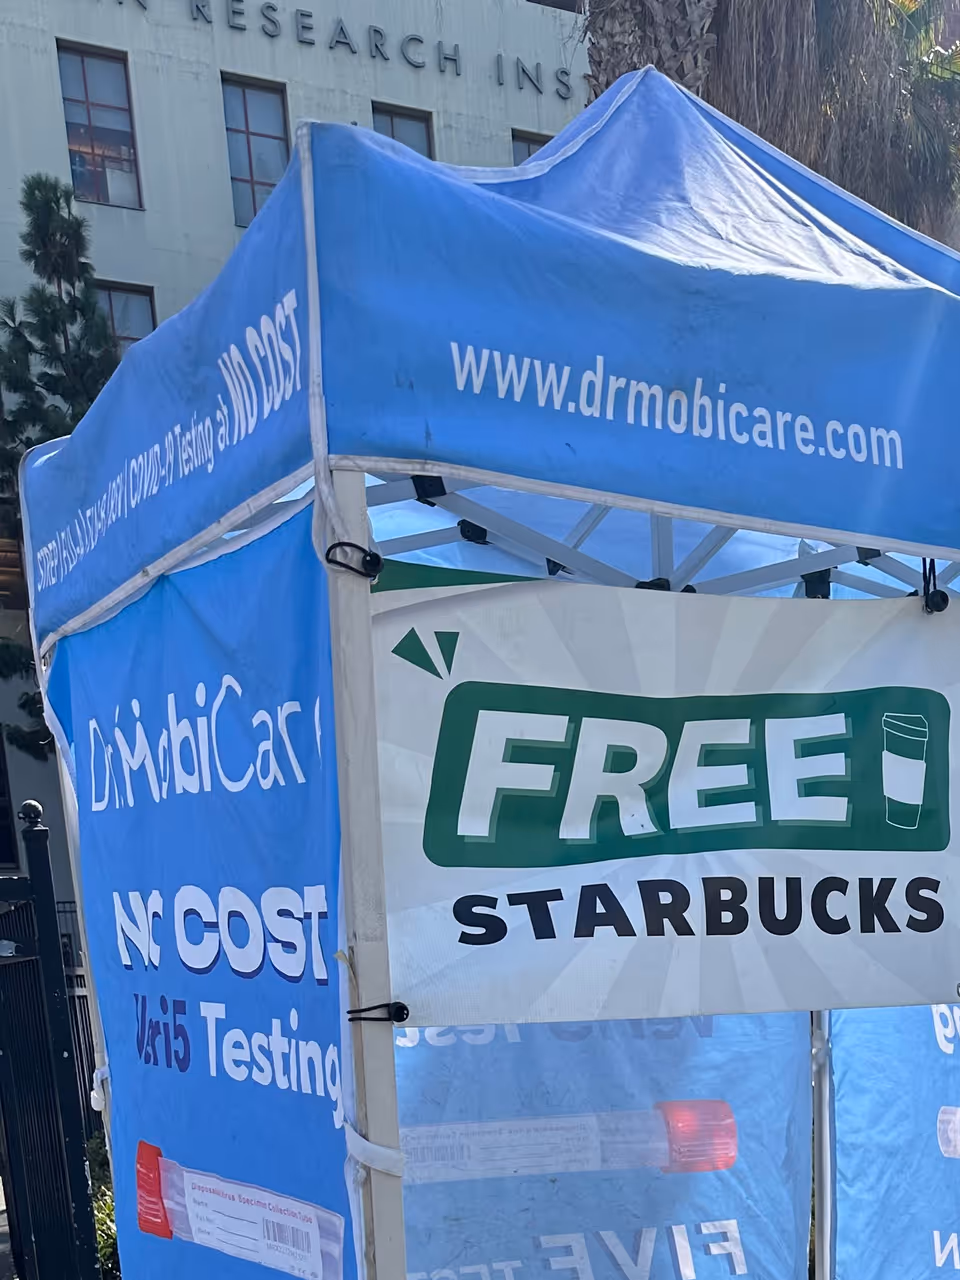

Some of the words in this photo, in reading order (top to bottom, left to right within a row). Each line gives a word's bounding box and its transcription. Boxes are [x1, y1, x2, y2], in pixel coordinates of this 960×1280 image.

[189, 0, 462, 77] RESEARCH
[217, 344, 258, 445] NO
[245, 288, 301, 420] COST
[174, 410, 215, 474] Testing
[216, 394, 230, 451] at
[450, 341, 904, 470] www.drmobicare.com
[130, 431, 174, 508] COVID-19
[37, 540, 58, 592] STREP
[456, 709, 852, 845] FREE
[174, 884, 329, 985] COST
[452, 876, 944, 946] STARBUCKS
[200, 1001, 345, 1129] Testing
